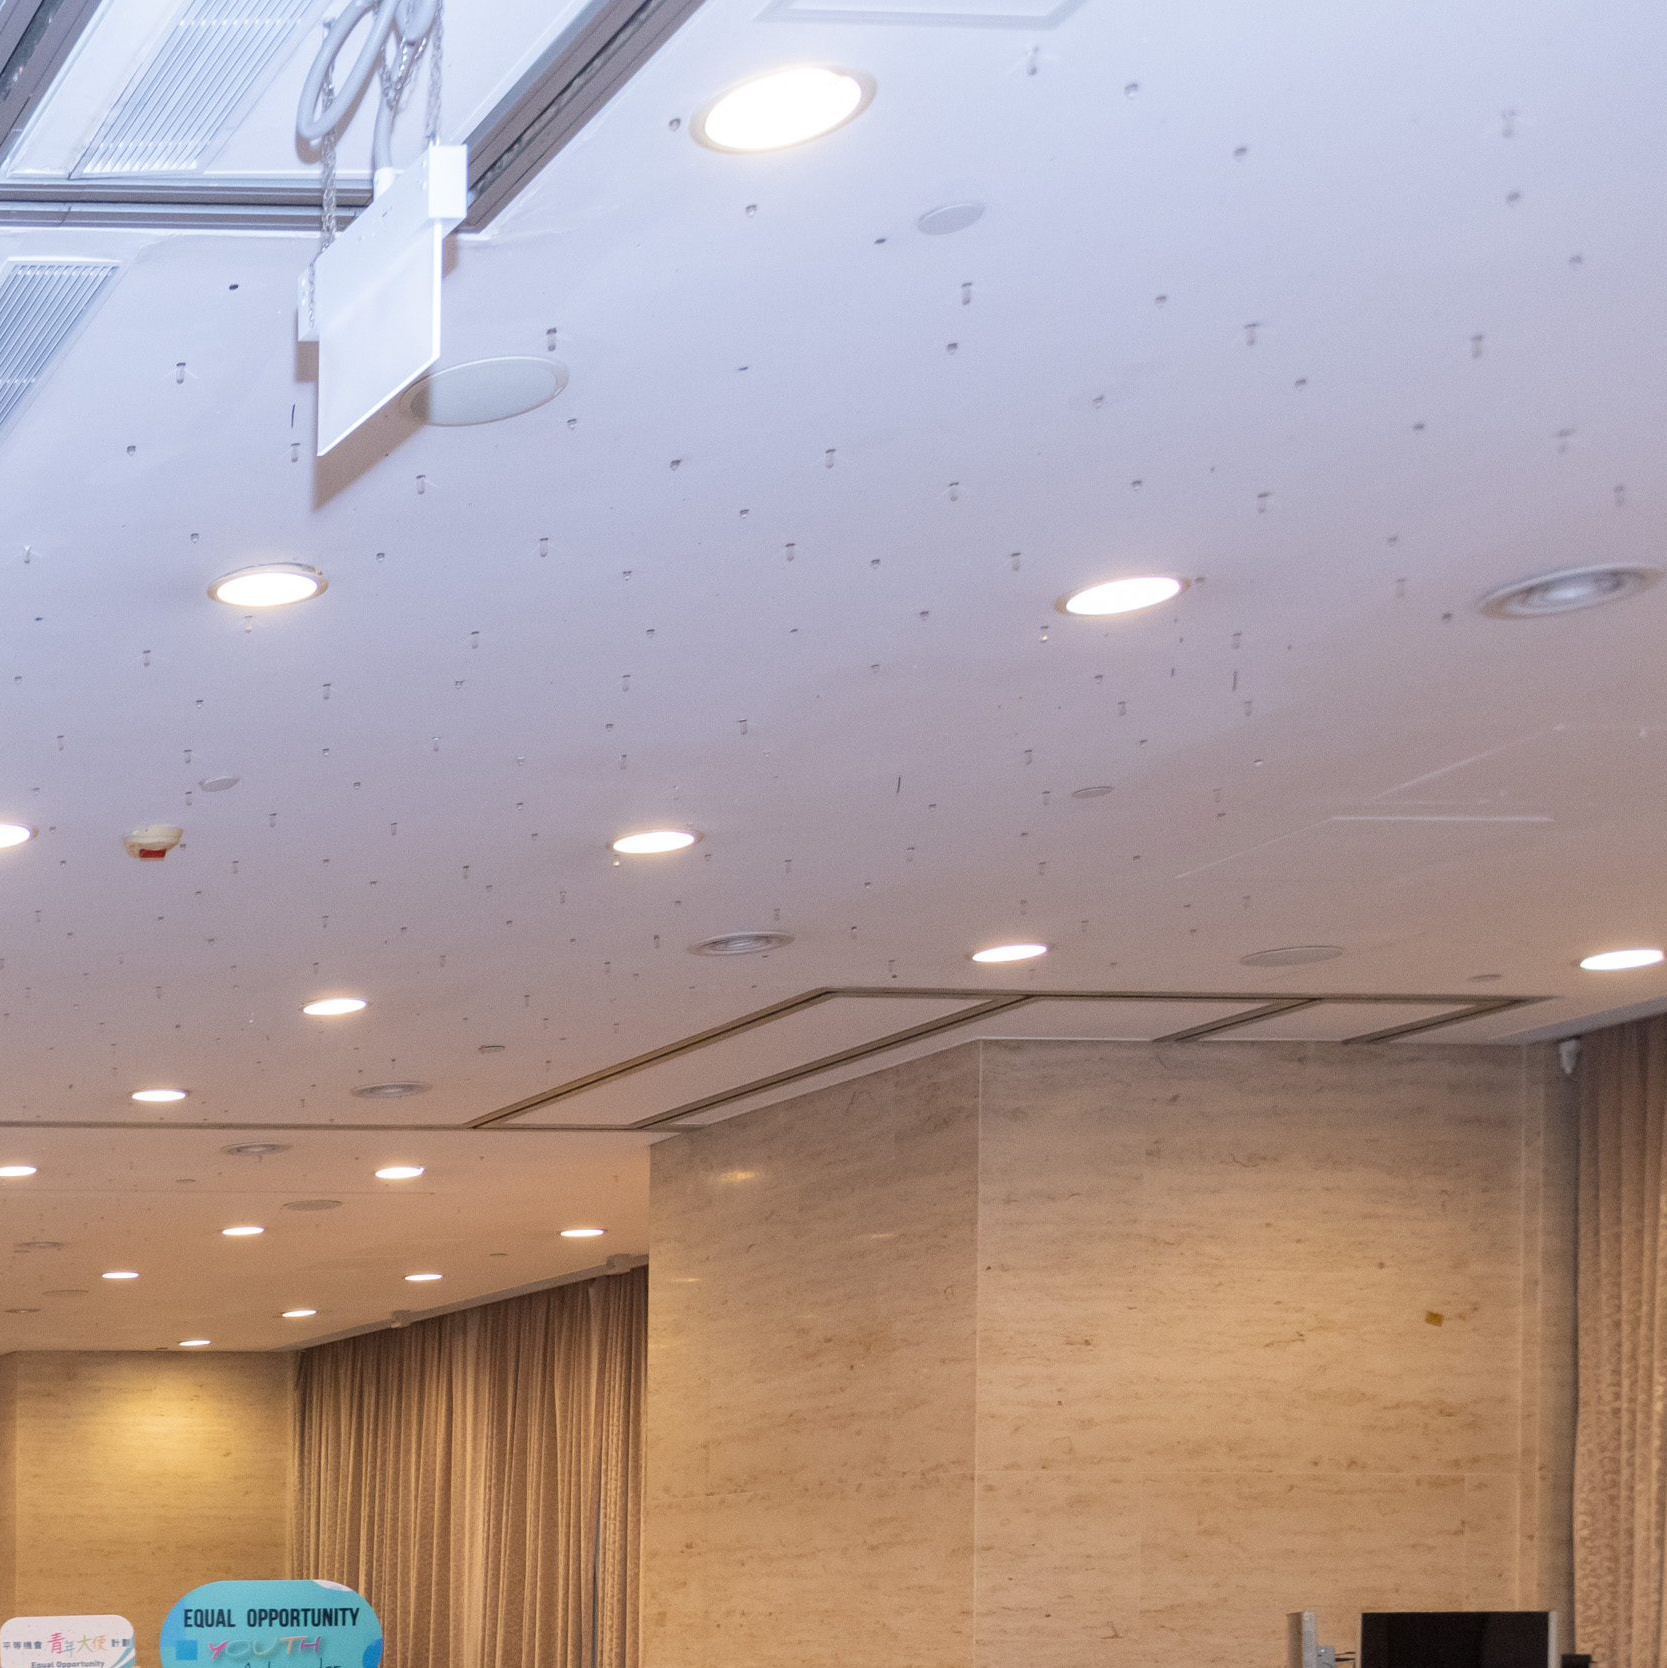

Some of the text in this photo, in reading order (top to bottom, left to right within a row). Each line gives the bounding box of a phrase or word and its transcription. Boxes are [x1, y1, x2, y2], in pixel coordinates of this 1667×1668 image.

[184, 1607, 360, 1629] EQUAL OPPORTUNITY
[208, 1636, 321, 1660] YOUTH
[56, 1659, 105, 1668] Opportunity
